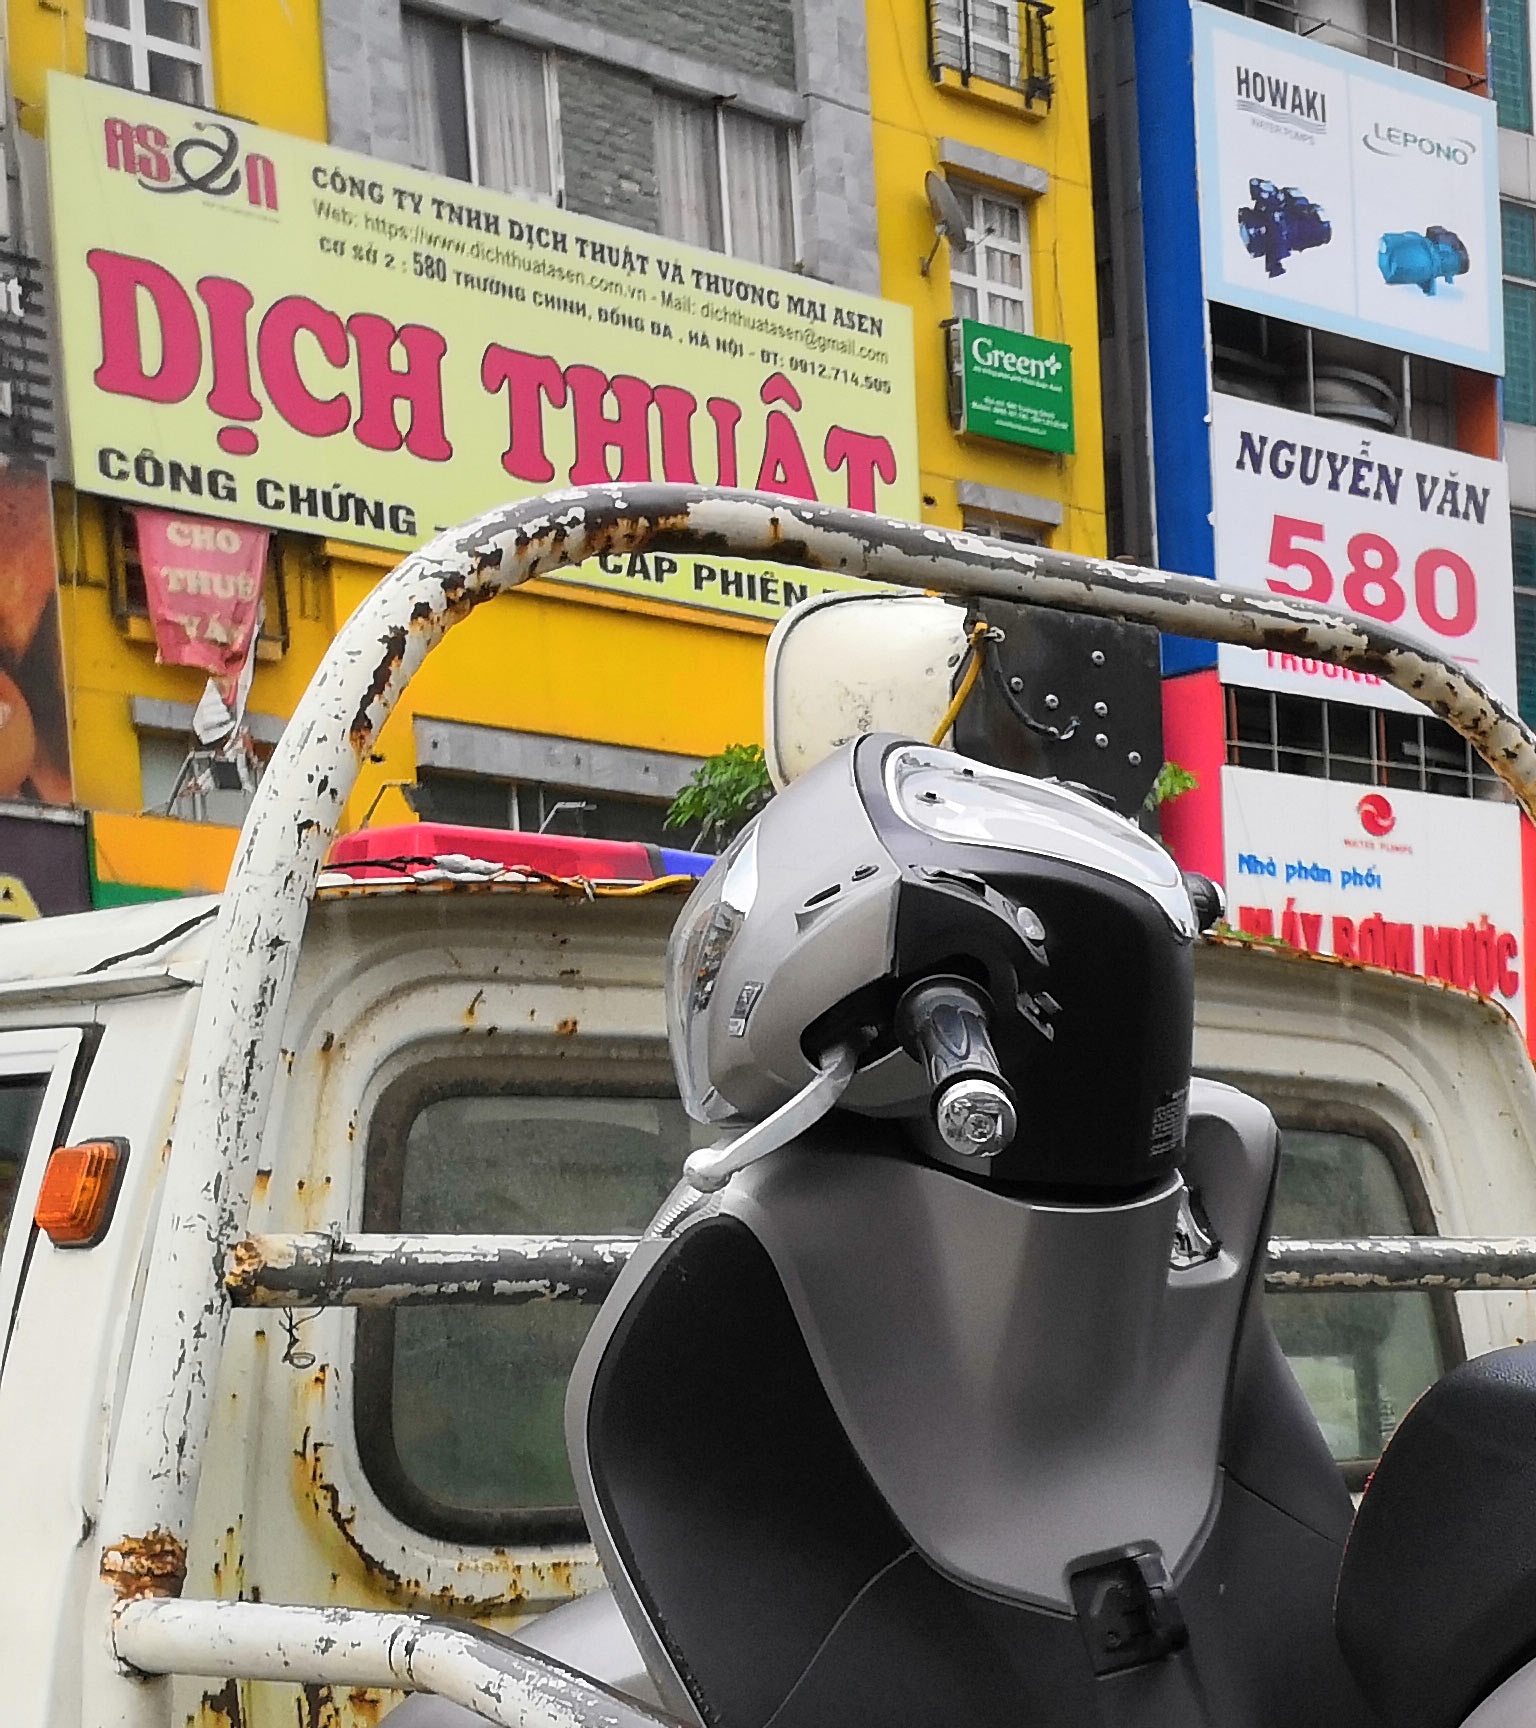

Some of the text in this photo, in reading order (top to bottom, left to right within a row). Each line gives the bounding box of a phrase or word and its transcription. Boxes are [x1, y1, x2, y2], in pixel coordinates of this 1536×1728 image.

[1237, 66, 1326, 122] HOWAKI
[1374, 122, 1468, 165] LEPONO
[312, 166, 384, 204] CÔNG
[393, 187, 423, 214] TY
[432, 197, 501, 236] TNHH
[508, 219, 568, 254] DỊCH
[656, 259, 685, 285] VÀ
[833, 308, 883, 338] ASEN
[413, 251, 447, 282] 580
[86, 247, 454, 462] DỊCH
[701, 301, 888, 365] dichthuatasen@gmail.com
[98, 447, 417, 537] CÔNG CHỨNG
[1236, 431, 1490, 524] NGUYỄN VĂN
[166, 521, 242, 554] CHO
[1265, 514, 1478, 638] 580
[1238, 853, 1276, 876] Nhà
[1332, 912, 1414, 974] BƠM
